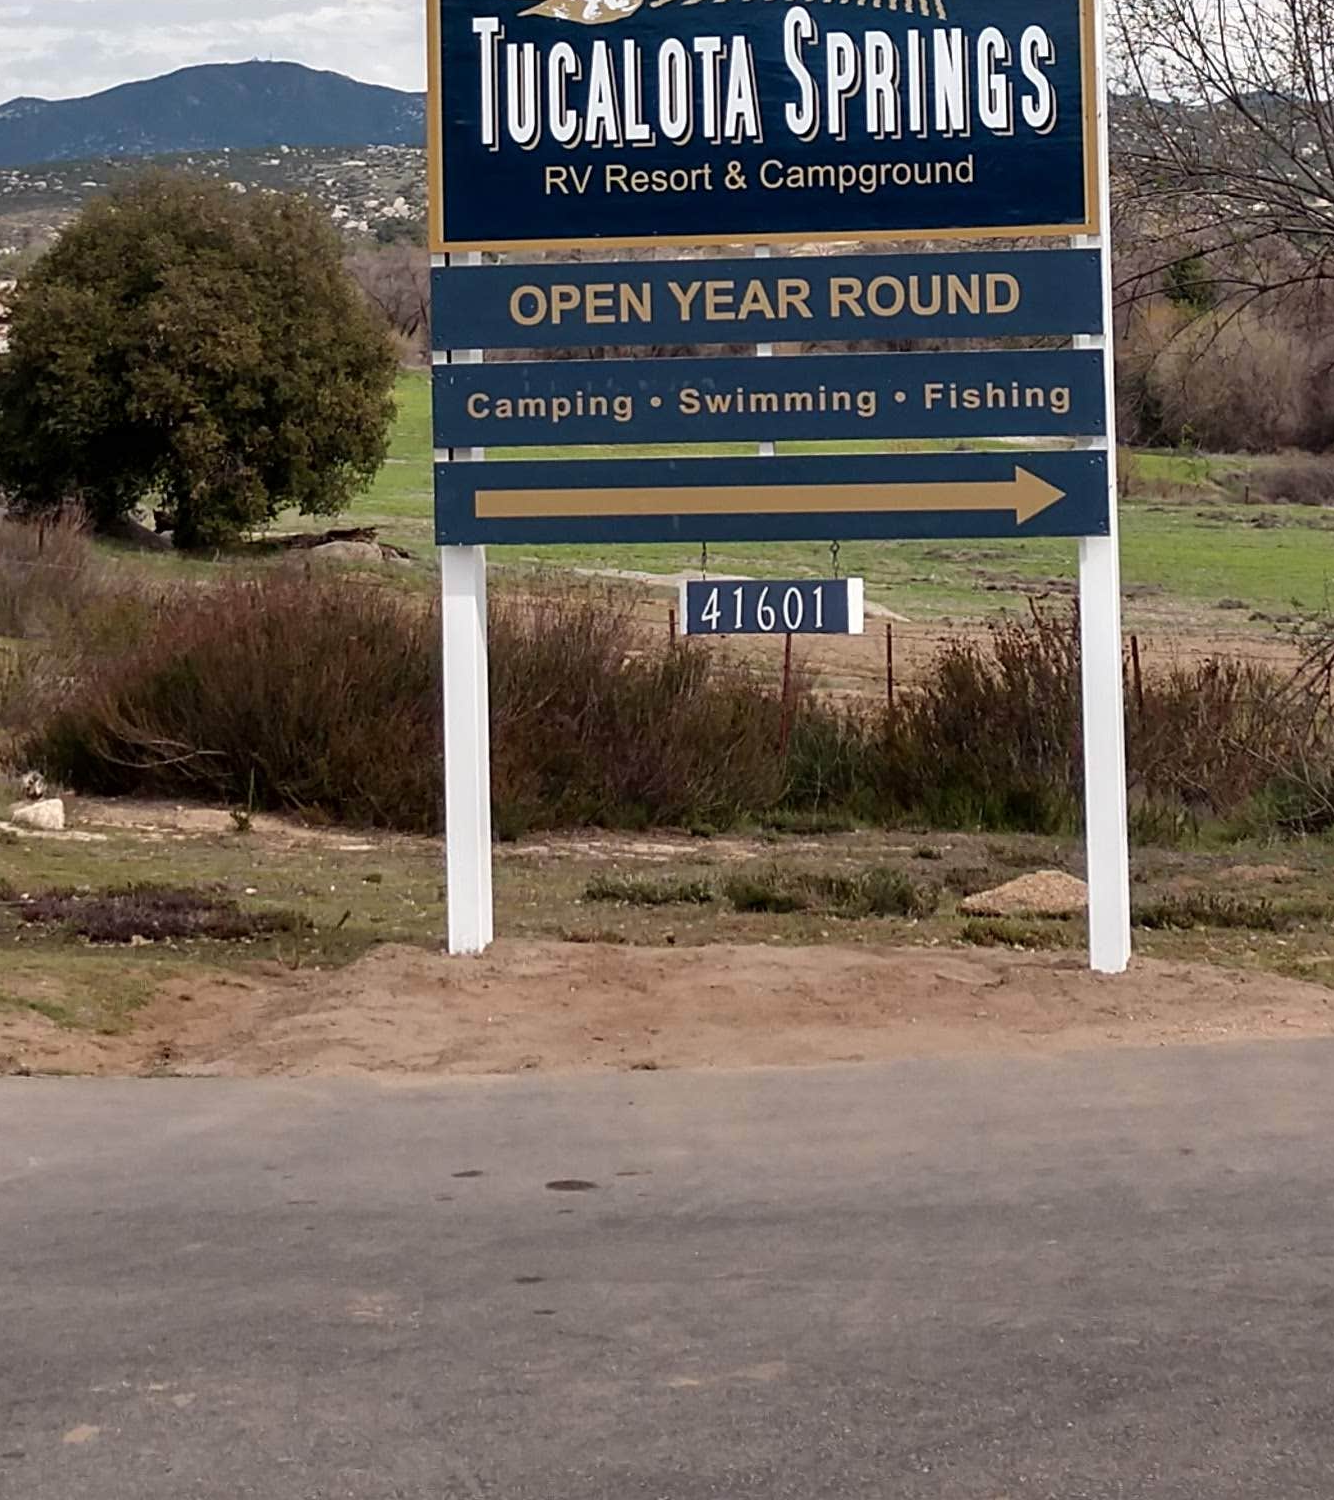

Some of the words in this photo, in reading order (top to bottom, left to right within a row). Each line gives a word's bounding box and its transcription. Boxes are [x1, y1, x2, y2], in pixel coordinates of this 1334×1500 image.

[472, 16, 763, 151] TUCALOTA
[783, 5, 1057, 142] SPRINGS
[545, 165, 593, 195] RV
[605, 162, 713, 193] Resort
[724, 160, 748, 190] &
[759, 153, 974, 194] Campground
[509, 282, 652, 326] OPEN
[667, 278, 814, 322] YEAR
[829, 273, 1020, 318] ROUND
[467, 390, 633, 423] Camping
[678, 385, 876, 418] Swimming
[924, 381, 1070, 414] Fishing
[700, 584, 824, 632] 41601
